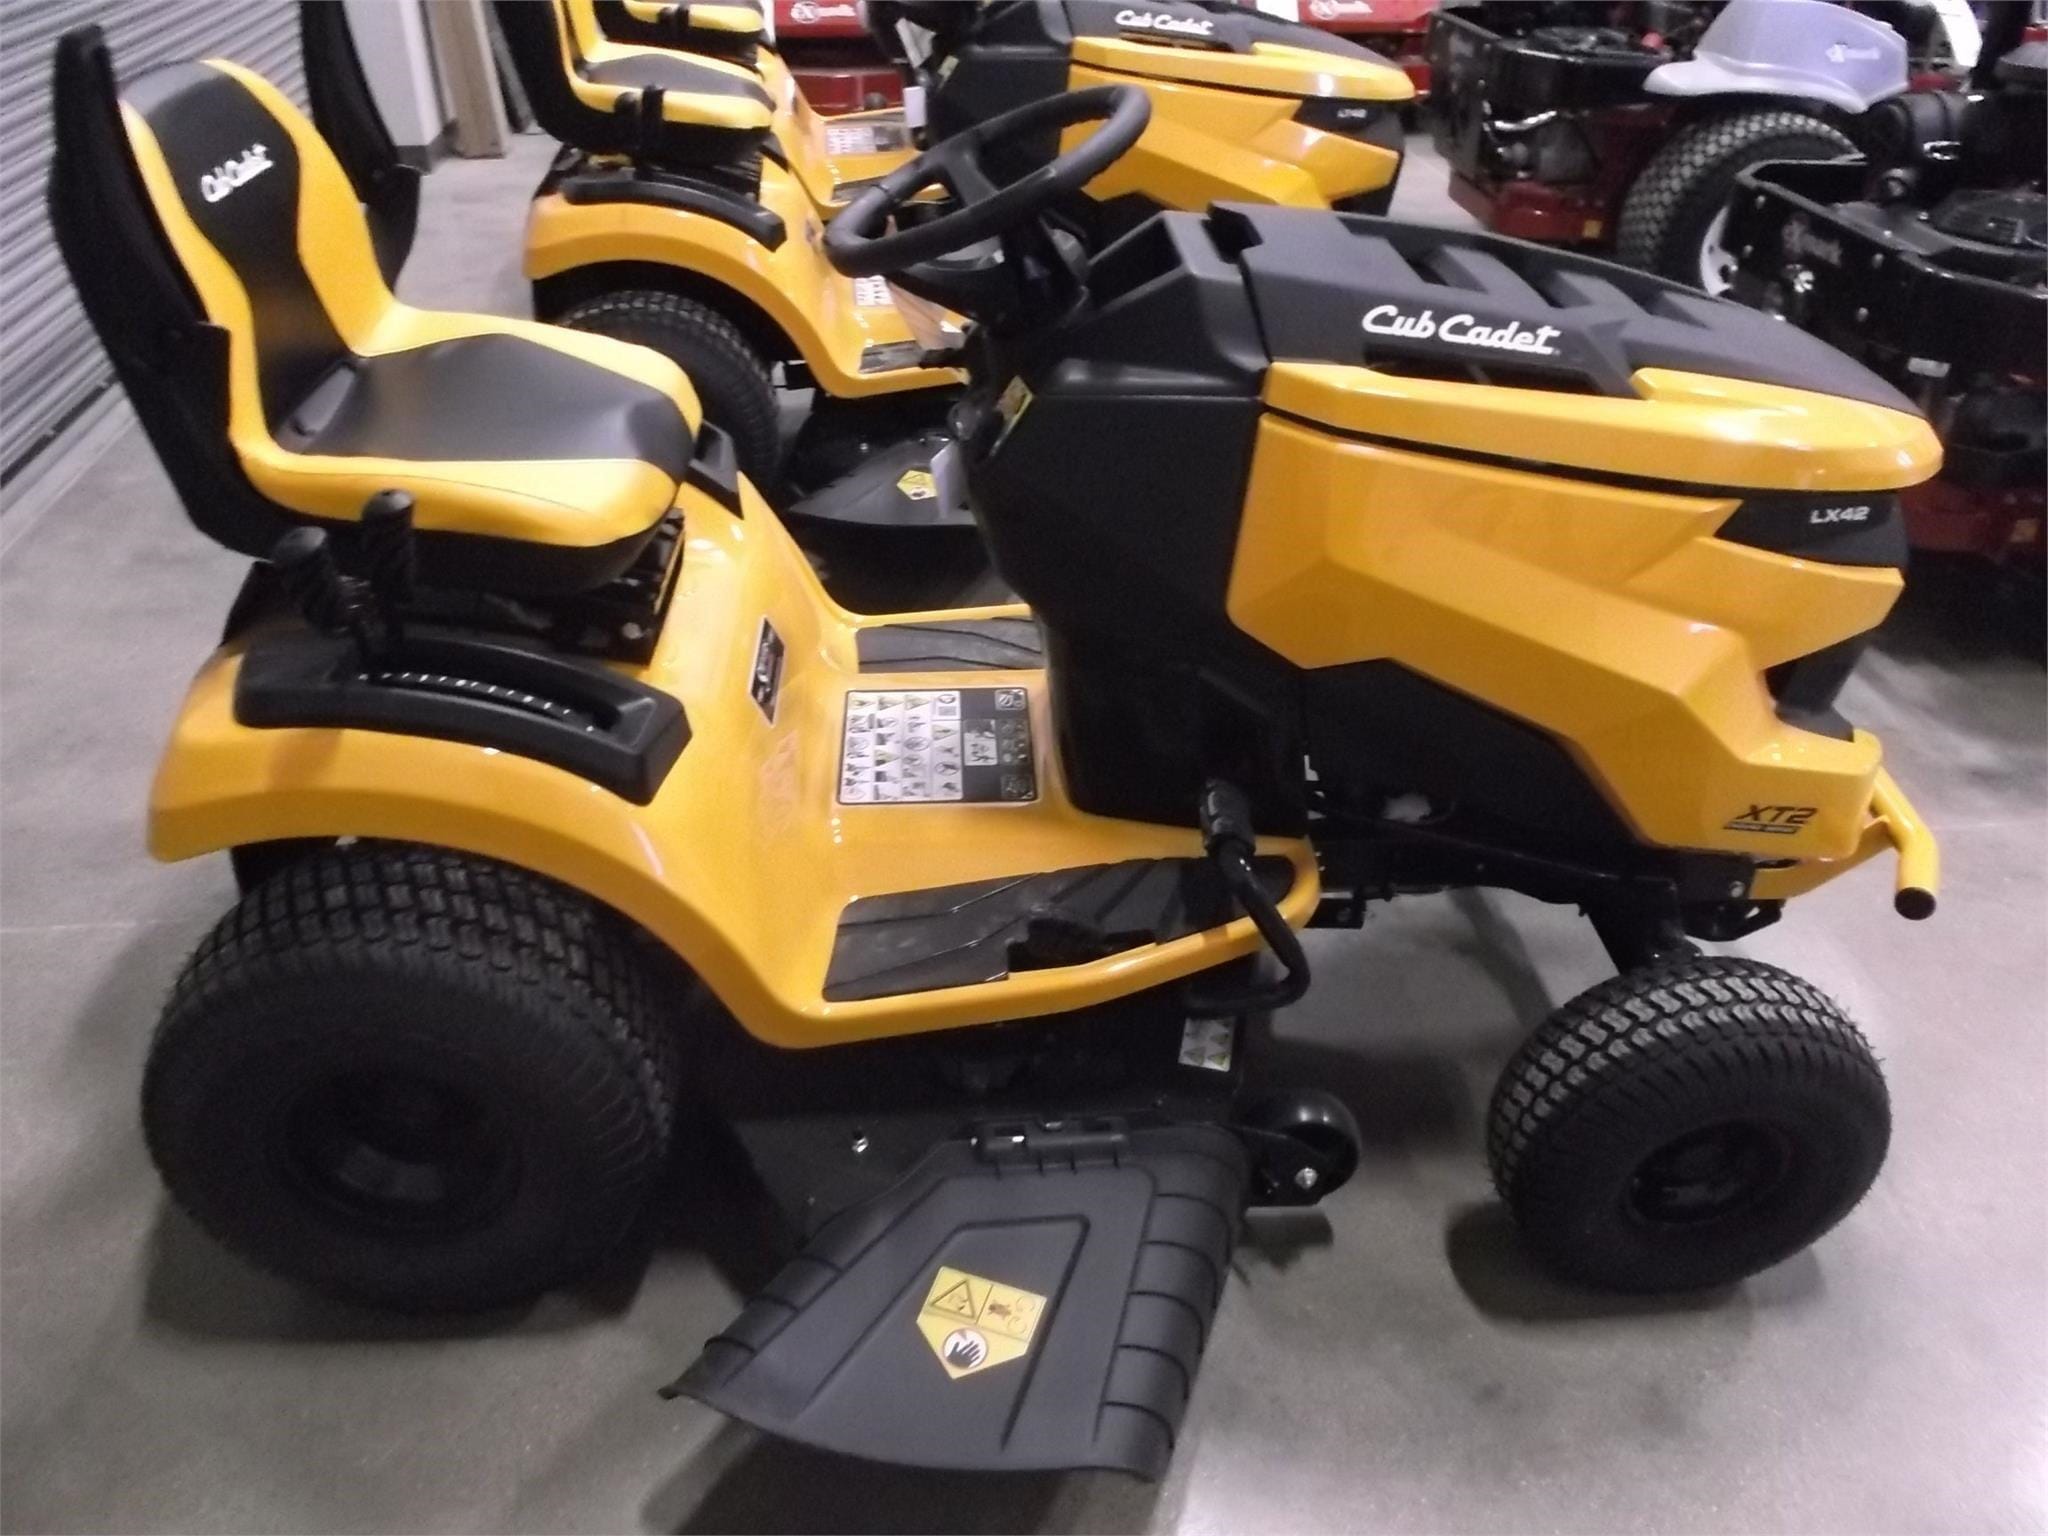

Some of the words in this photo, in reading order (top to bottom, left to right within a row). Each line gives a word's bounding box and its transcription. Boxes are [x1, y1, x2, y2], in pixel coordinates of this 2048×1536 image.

[1362, 304, 1436, 339] Cub
[1438, 313, 1561, 355] Cadet
[1809, 505, 1871, 524] LX42
[1735, 804, 1819, 825] XT2
